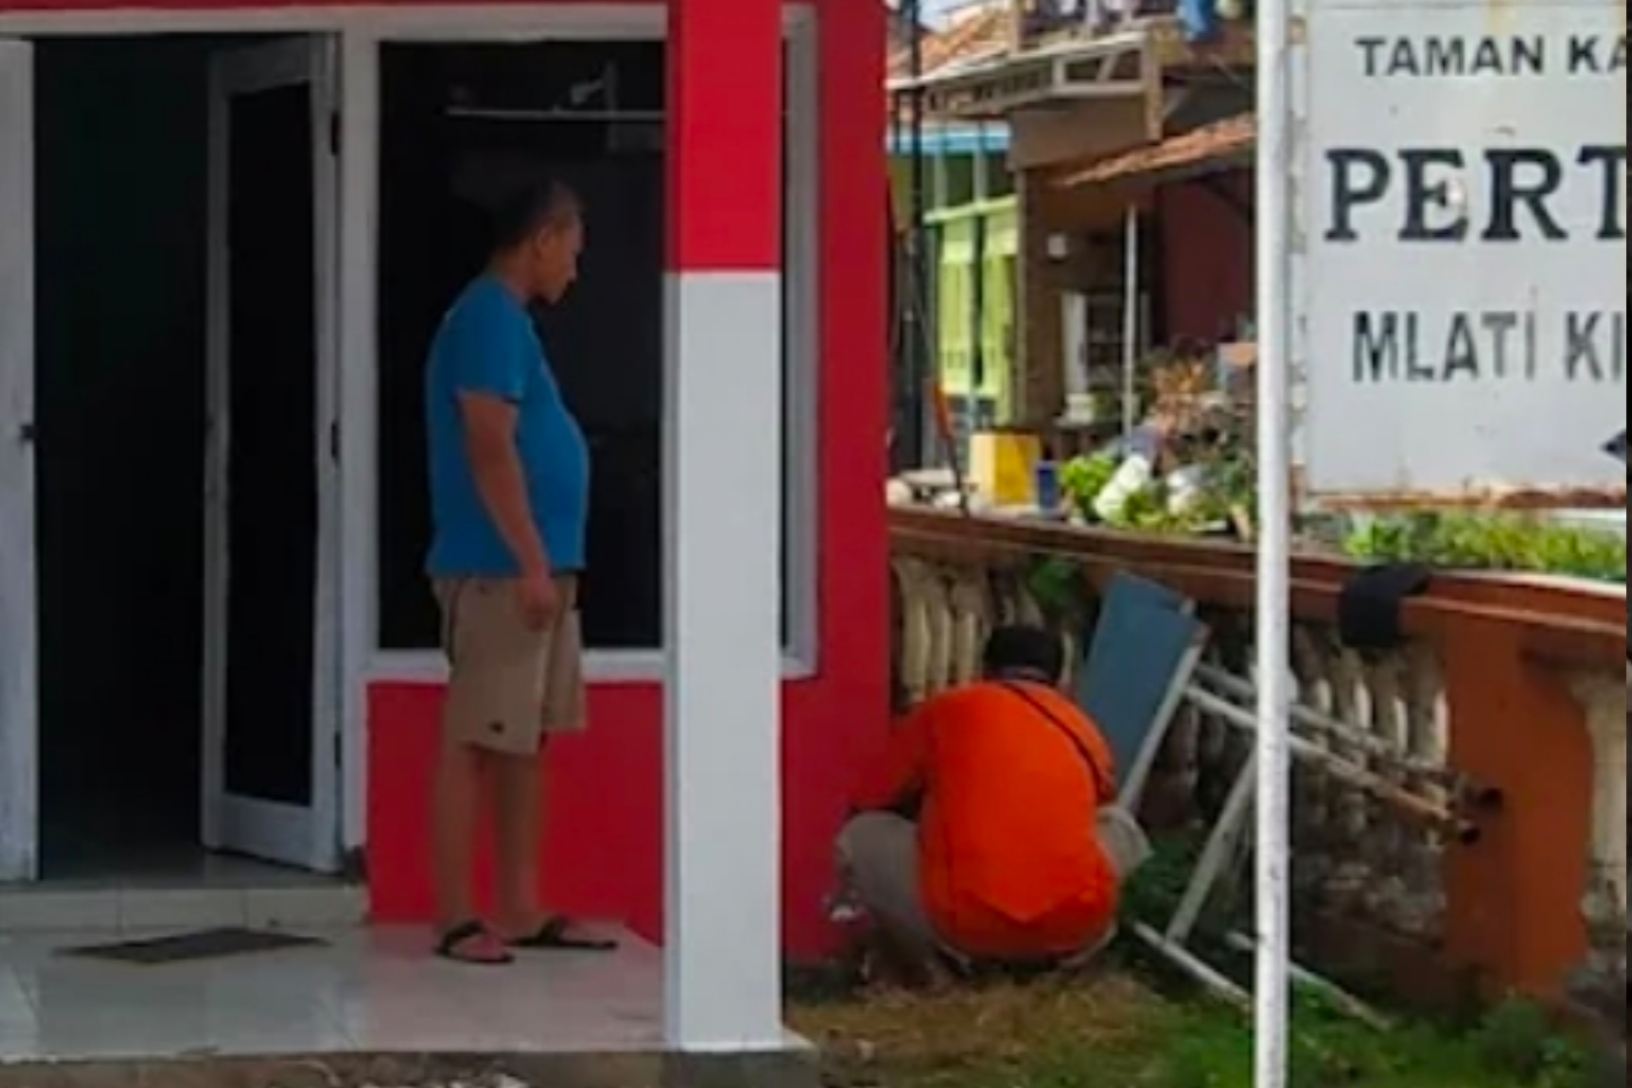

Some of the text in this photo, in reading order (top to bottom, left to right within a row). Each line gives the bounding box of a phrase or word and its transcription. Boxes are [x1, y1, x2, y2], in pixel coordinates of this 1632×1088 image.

[1355, 35, 1544, 76] TAMAN
[1324, 145, 1626, 242] PERT
[1352, 311, 1536, 383] MLATI
